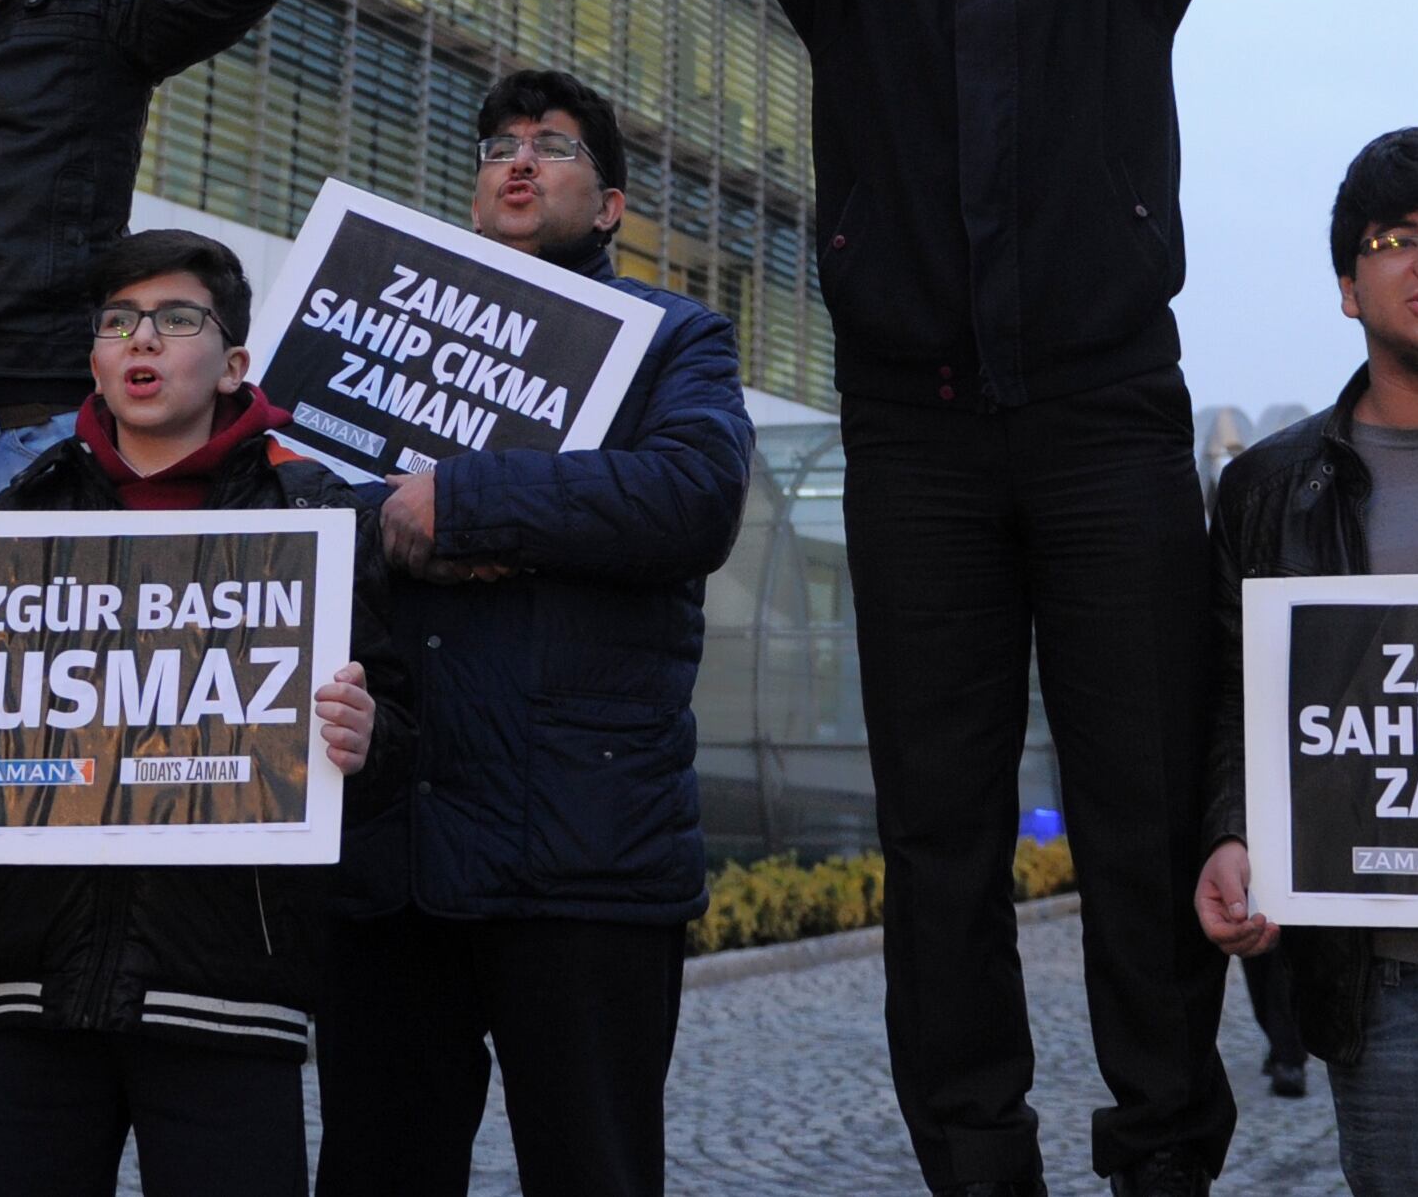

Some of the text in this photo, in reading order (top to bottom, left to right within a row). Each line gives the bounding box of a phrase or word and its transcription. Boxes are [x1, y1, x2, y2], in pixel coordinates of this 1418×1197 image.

[379, 263, 538, 358] ZAMAN
[301, 288, 569, 430] SAHİP ÇIKMA
[296, 406, 365, 446] ZAMAN
[328, 351, 498, 451] ZAMANI
[137, 580, 302, 630] BASIN
[186, 758, 239, 780] ZAMAN
